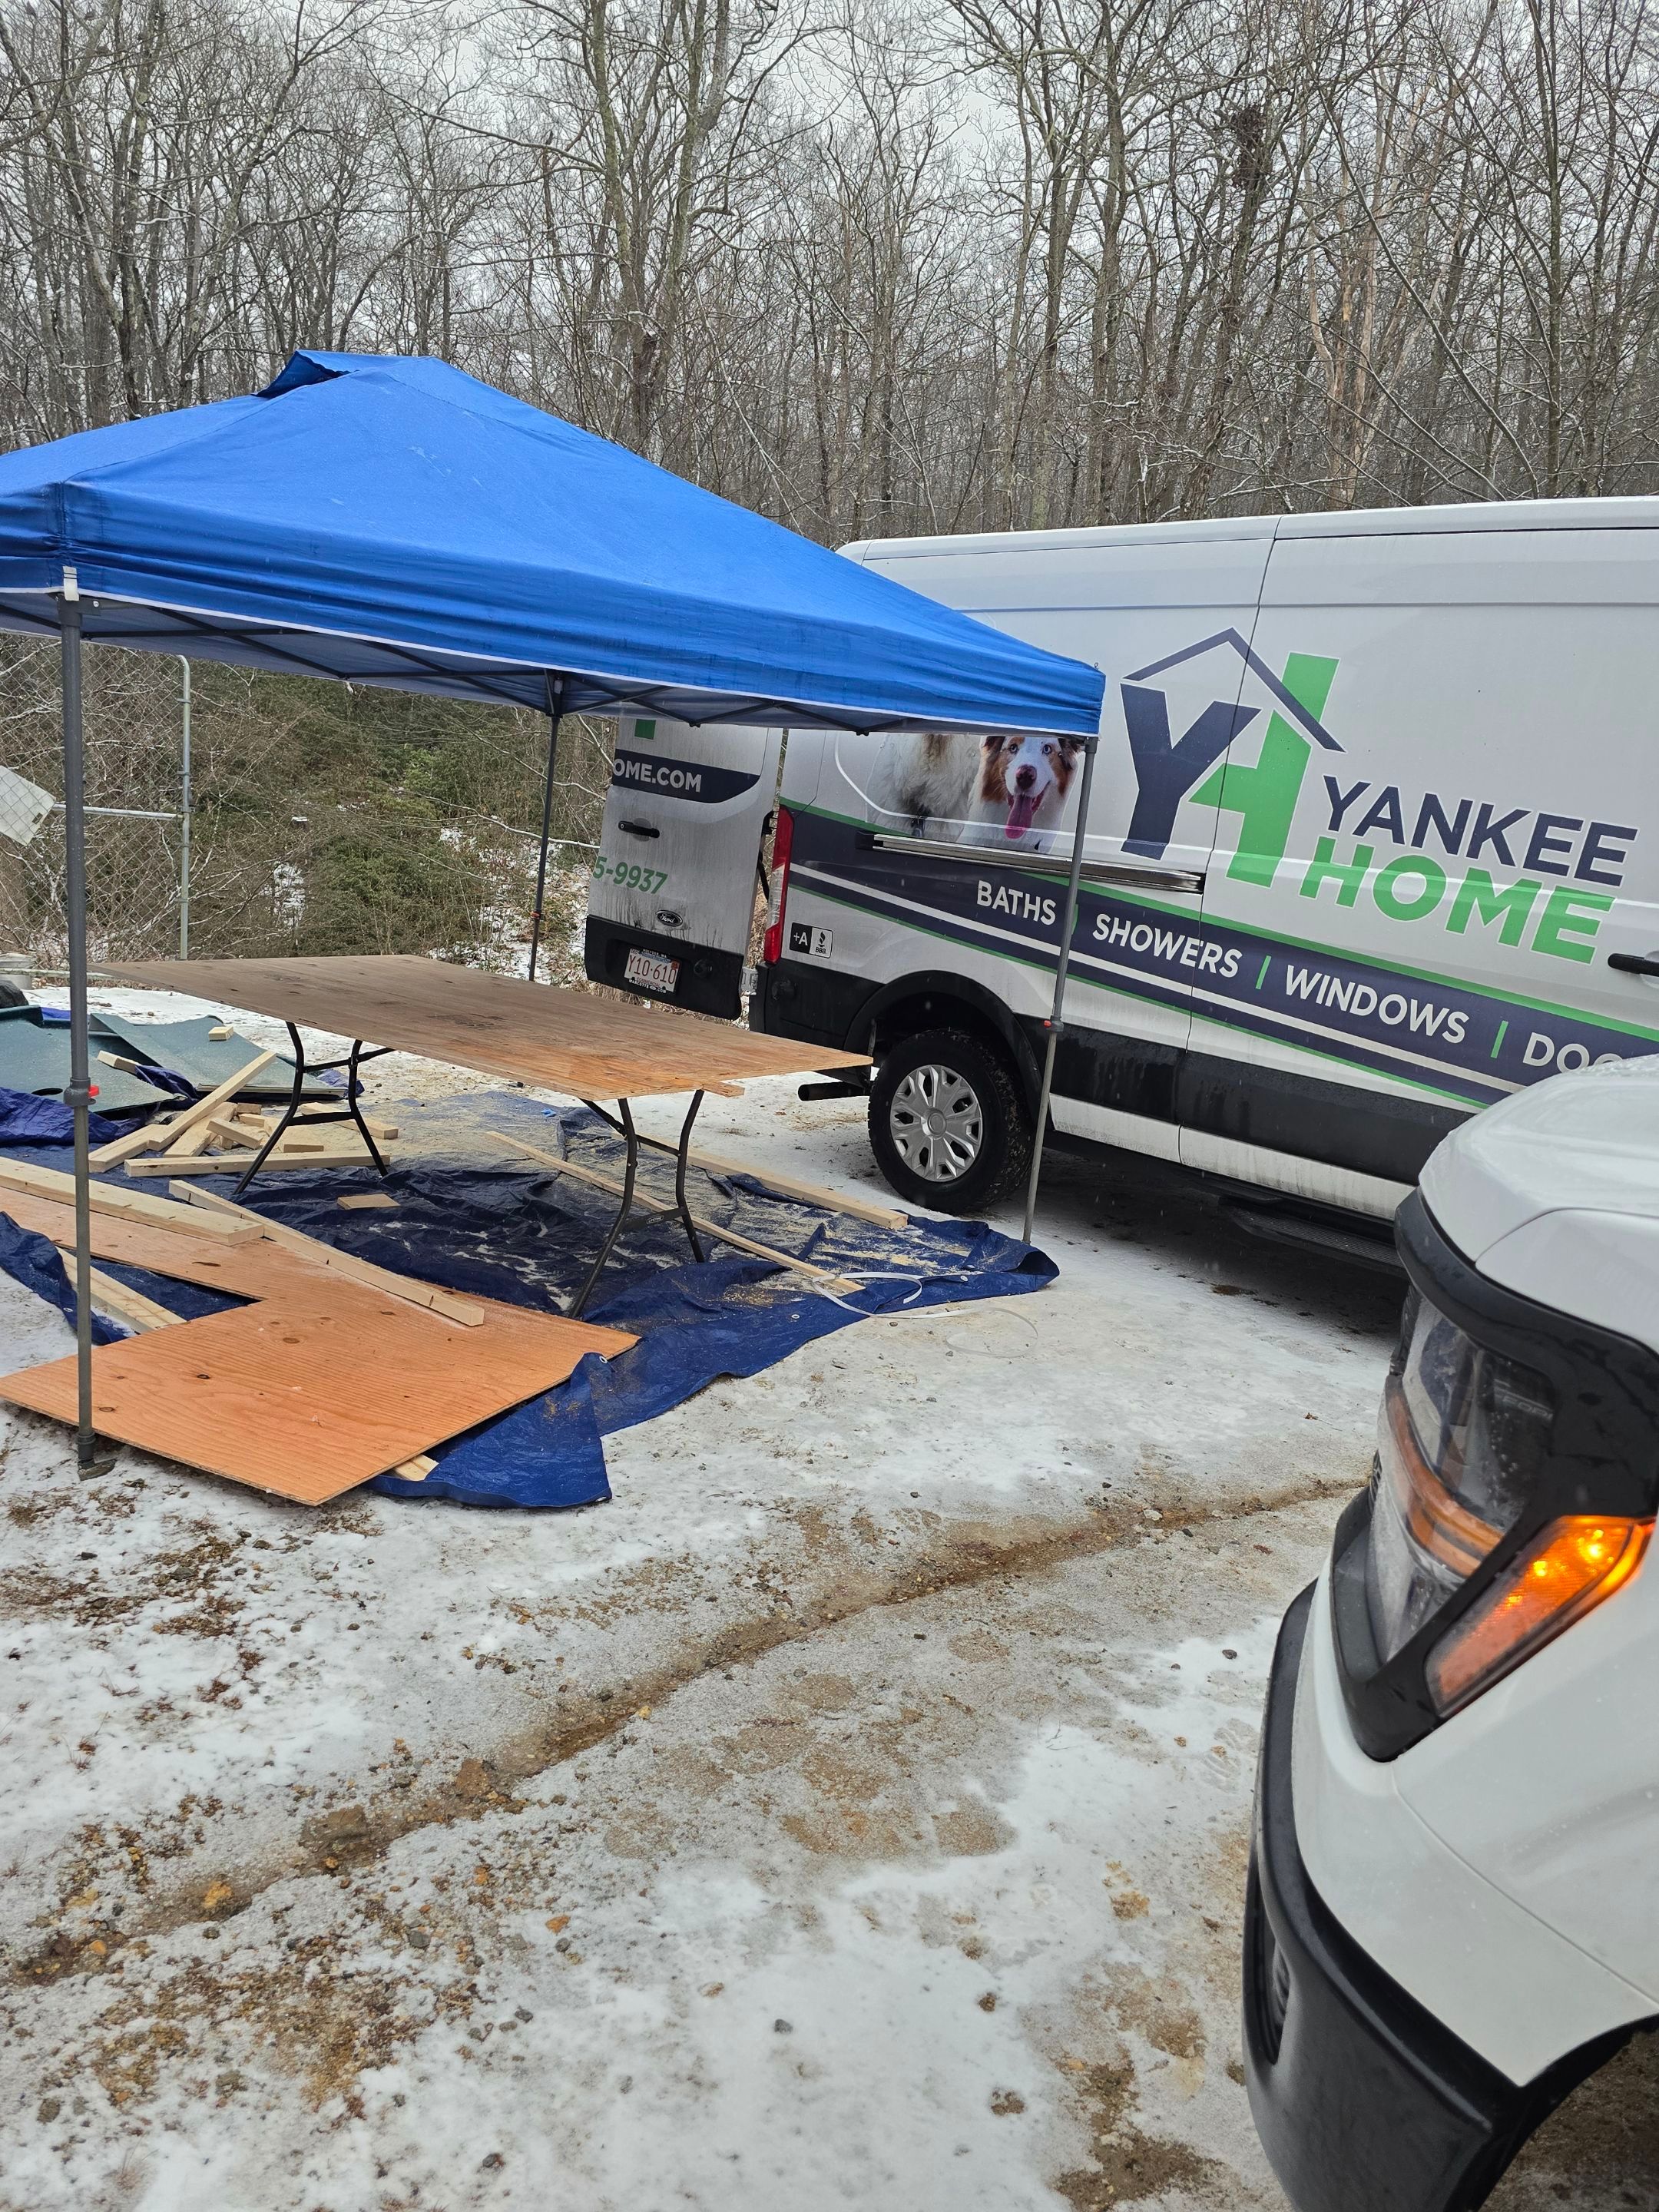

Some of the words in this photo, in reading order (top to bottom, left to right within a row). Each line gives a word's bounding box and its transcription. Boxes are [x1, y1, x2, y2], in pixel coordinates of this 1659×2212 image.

[592, 856, 668, 894] 5-9937
[1323, 775, 1640, 887] YANKEE
[1299, 836, 1617, 966] HOME
[976, 880, 1056, 925] BATHS
[1092, 914, 1243, 979] SHOWERS
[1285, 965, 1469, 1044] WINDOWS
[1522, 1031, 1624, 1074] DO
